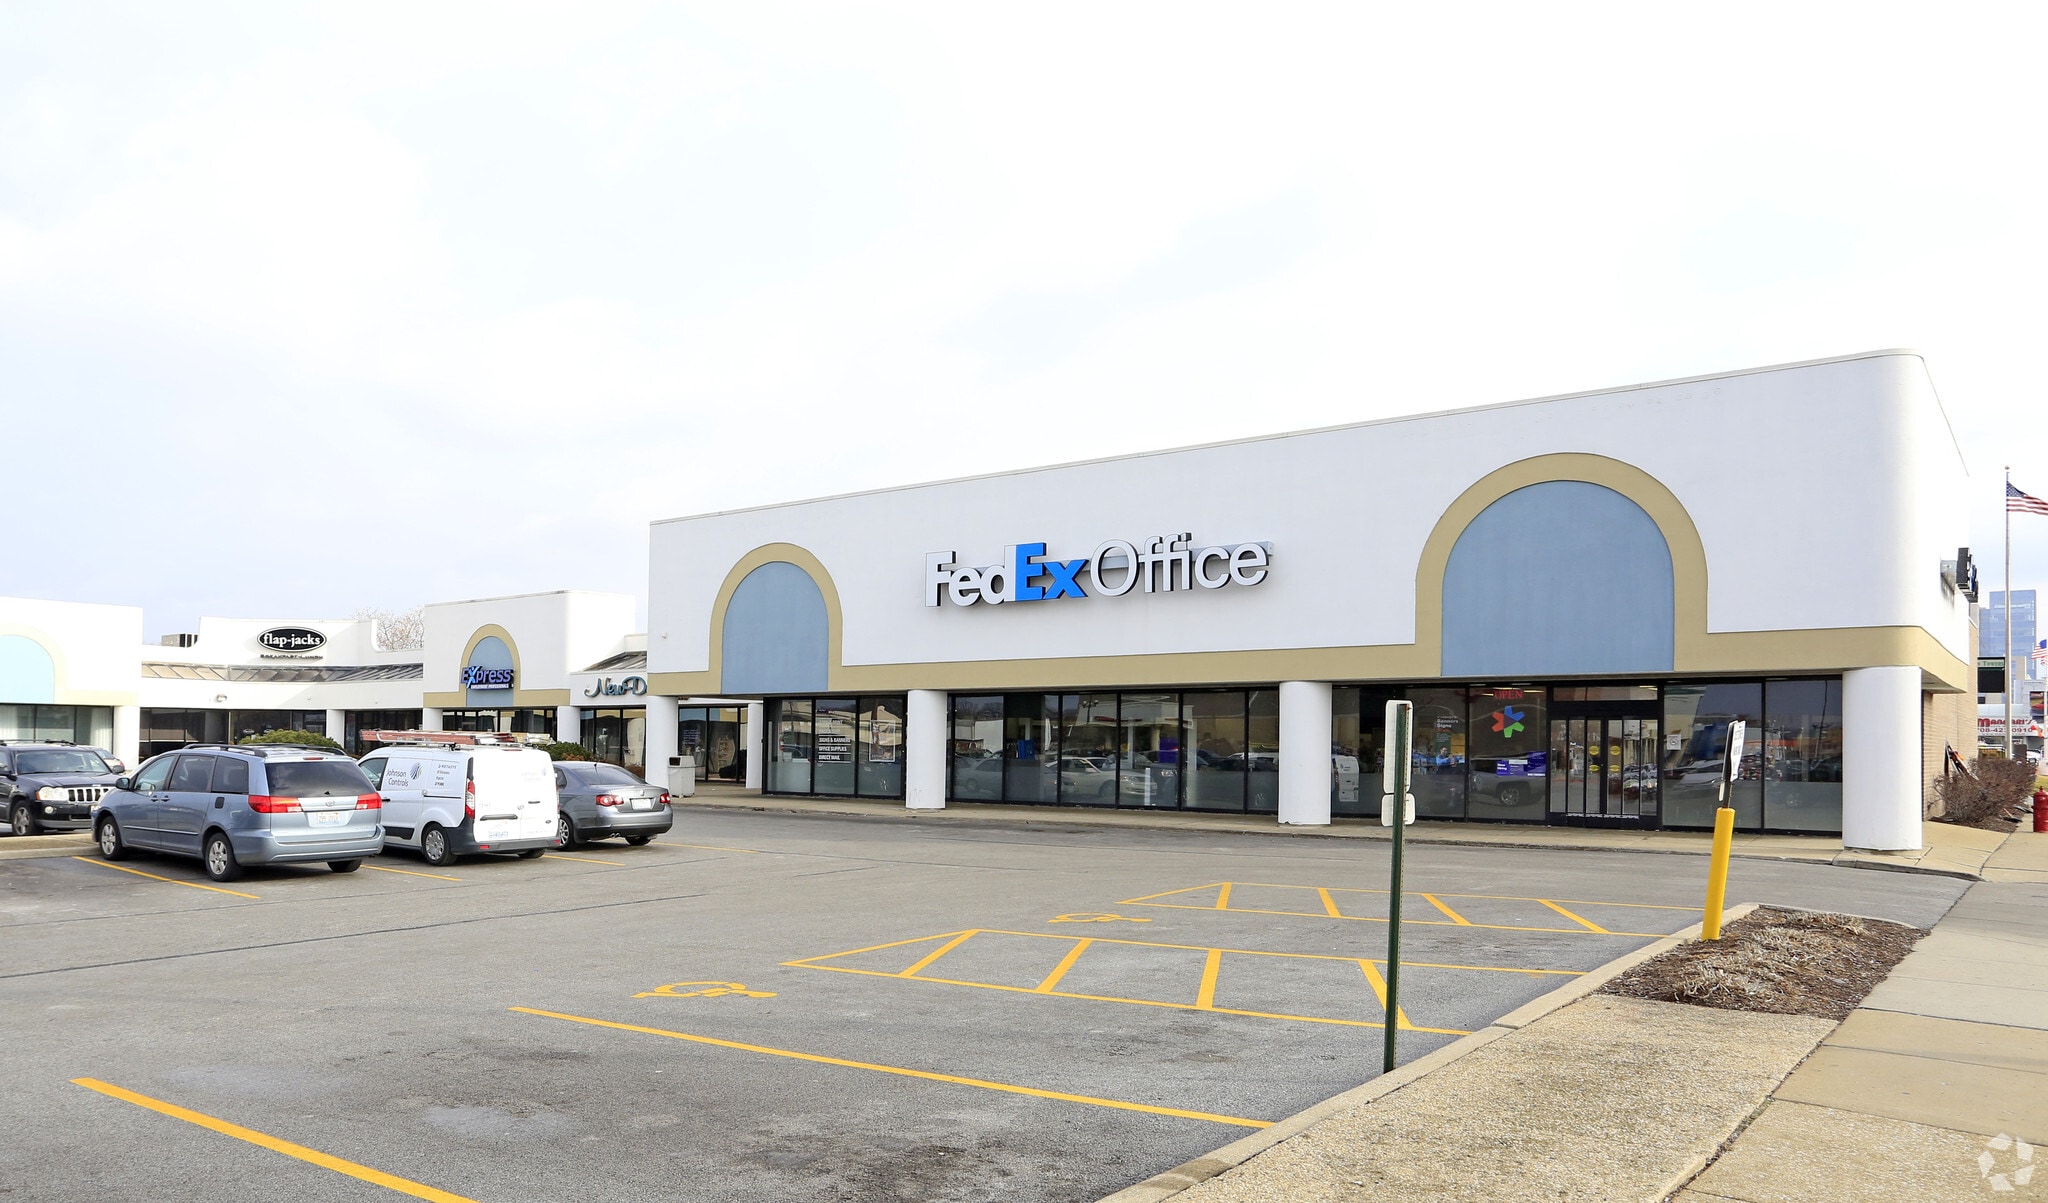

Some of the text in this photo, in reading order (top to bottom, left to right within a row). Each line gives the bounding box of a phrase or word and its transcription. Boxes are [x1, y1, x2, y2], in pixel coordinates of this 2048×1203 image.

[925, 532, 1269, 607] FedEx Office
[263, 633, 321, 648] flap-jacks
[583, 677, 626, 698] New
[1493, 690, 1523, 700] OPEN
[385, 767, 407, 778] Johnson
[388, 777, 409, 787] Controls
